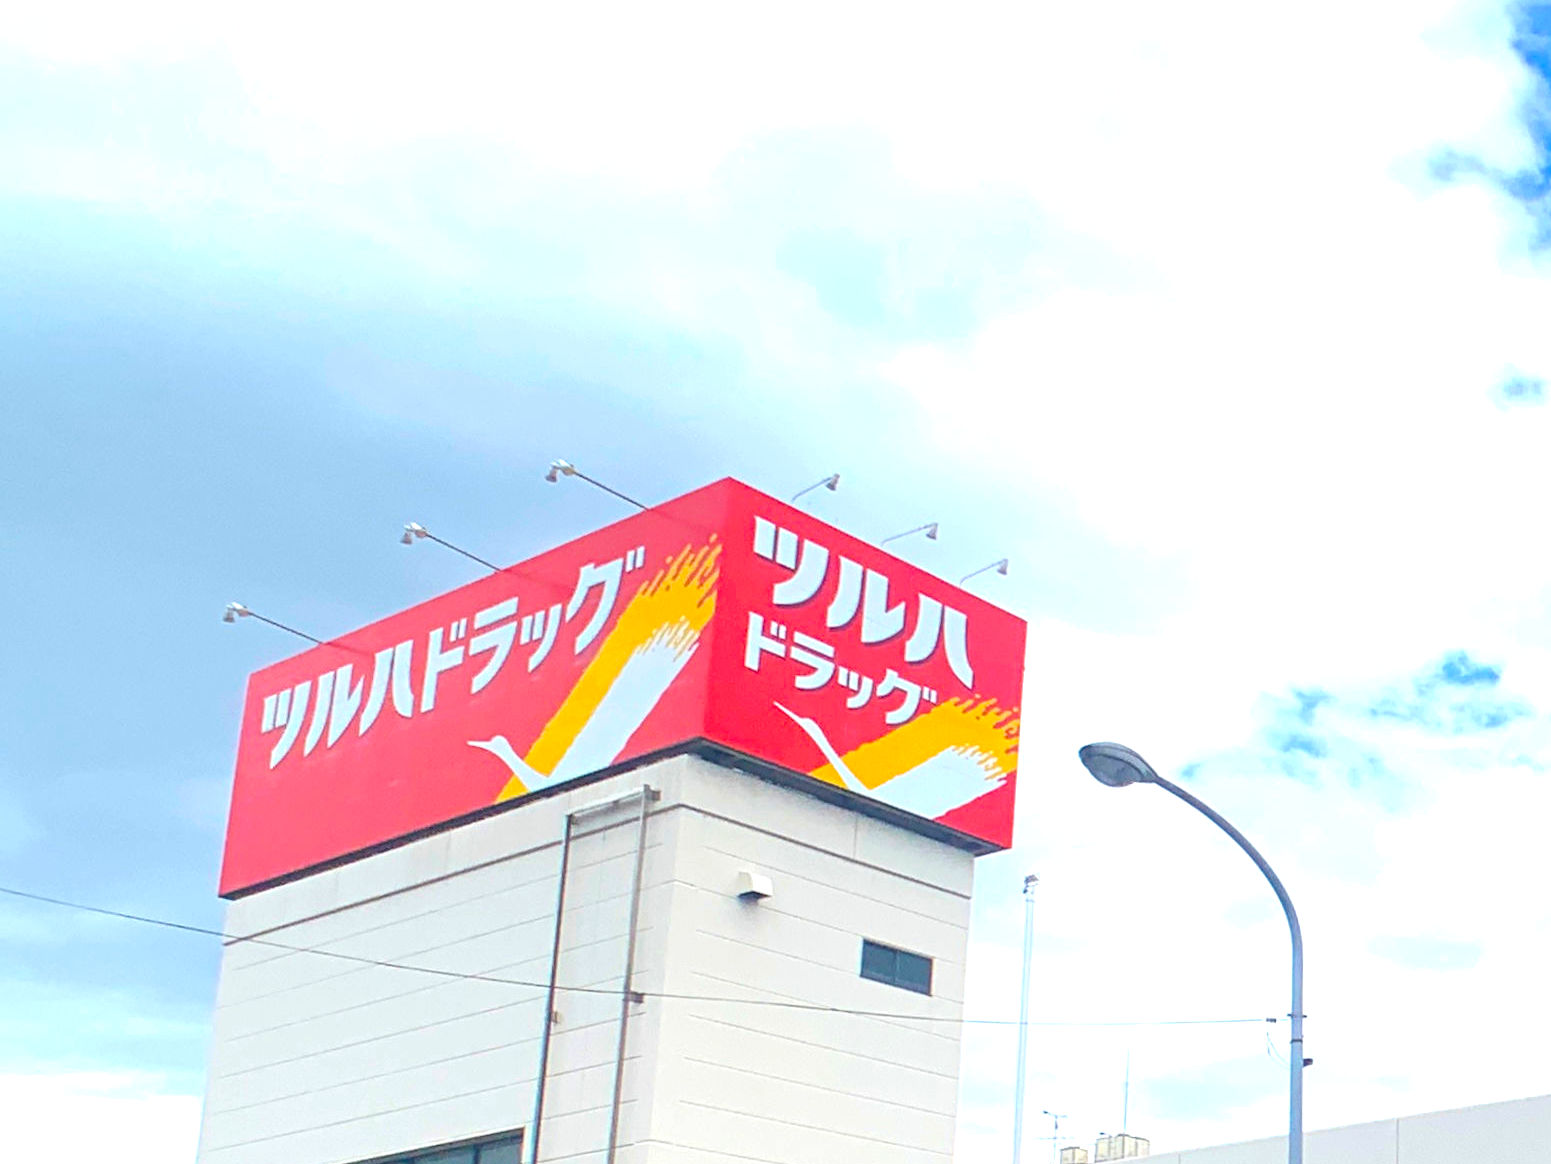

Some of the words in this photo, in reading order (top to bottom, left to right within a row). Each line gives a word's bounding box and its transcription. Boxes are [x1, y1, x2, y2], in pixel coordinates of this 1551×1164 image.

[261, 545, 646, 770] ツルハドラッグ
[744, 611, 939, 726] ドラッグ
[752, 515, 975, 689] ツルハ
